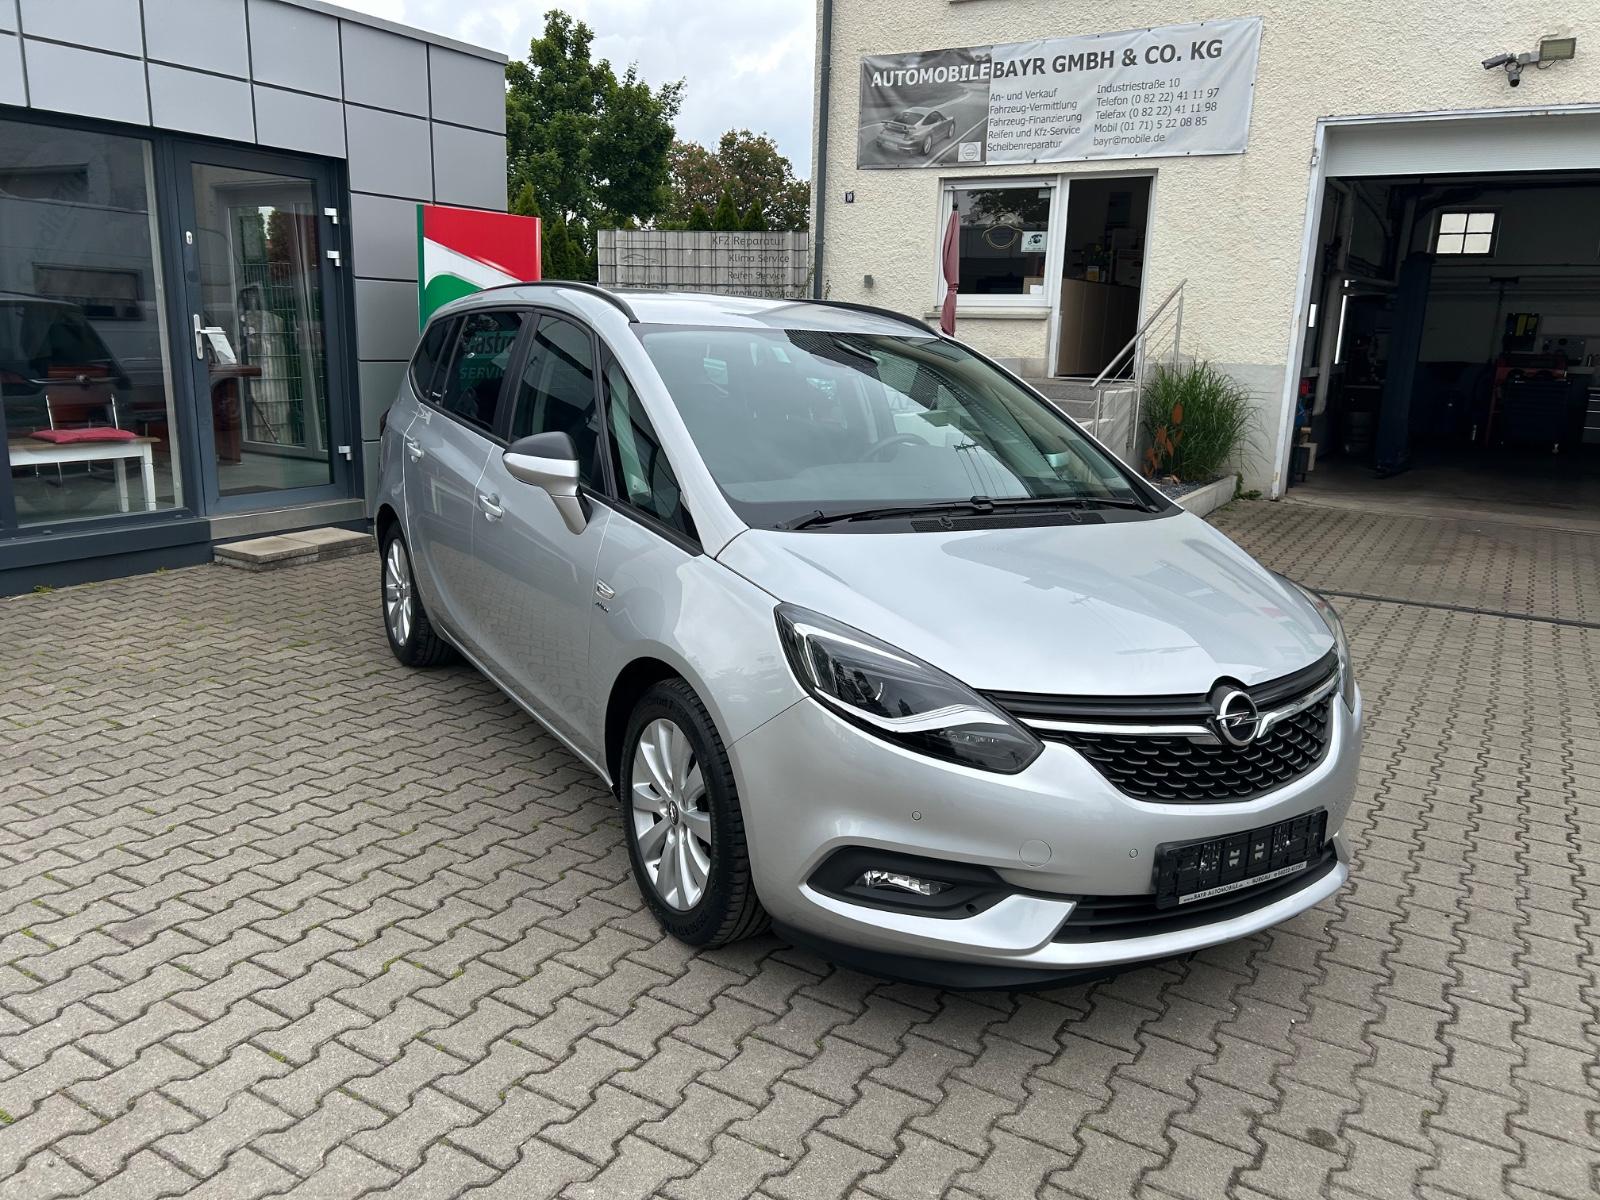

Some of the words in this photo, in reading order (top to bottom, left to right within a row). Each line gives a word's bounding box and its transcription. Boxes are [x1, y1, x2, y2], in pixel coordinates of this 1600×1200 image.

[871, 62, 990, 87] AUTOMOBILE
[993, 58, 1046, 78] BAYR
[1052, 51, 1115, 73] GMBH
[1121, 48, 1138, 66] &
[1144, 43, 1182, 64] CO.
[1190, 39, 1223, 60] KG
[1097, 79, 1166, 93] Industriestraße
[1169, 78, 1180, 88] 10
[990, 92, 1004, 101] An-
[1007, 91, 1023, 100] und
[1025, 88, 1058, 99] Verkauf
[1097, 96, 1128, 106] Telefon
[1131, 94, 1141, 106] (0
[1143, 93, 1155, 103] 82
[1158, 91, 1174, 102] 22)
[1177, 91, 1188, 100] 41
[1193, 90, 1203, 99] 11
[1206, 87, 1220, 98] 97
[990, 101, 1078, 114] Fahrzeug-Vermittlung
[1096, 109, 1126, 120] Telefax
[1128, 108, 1139, 119] (0
[1141, 107, 1153, 117] 82
[1156, 105, 1172, 117] 22)
[1175, 104, 1186, 114] 41
[1190, 103, 1201, 113] 11
[1205, 102, 1217, 112] 98
[989, 113, 1082, 126] Fahrzeug-Finanzierung
[1094, 122, 1118, 133] Mobil
[1120, 121, 1135, 133] (01
[1138, 120, 1154, 132] 71)
[1156, 120, 1163, 129] 5
[1165, 118, 1177, 128] 22
[1180, 117, 1192, 127] 08
[1195, 116, 1207, 126] 85
[988, 129, 1013, 139] Reifen
[1016, 128, 1032, 138] und
[1034, 126, 1081, 137] Kfz-Service
[987, 140, 1062, 152] Scheibenreparatur
[1093, 133, 1166, 147] bayr@mobile.de
[713, 236, 729, 246] KFZ
[733, 236, 785, 247] Reparatur
[729, 253, 754, 263] Klima
[758, 253, 789, 263] Service
[728, 270, 753, 280] Reifen
[756, 271, 786, 280] Service
